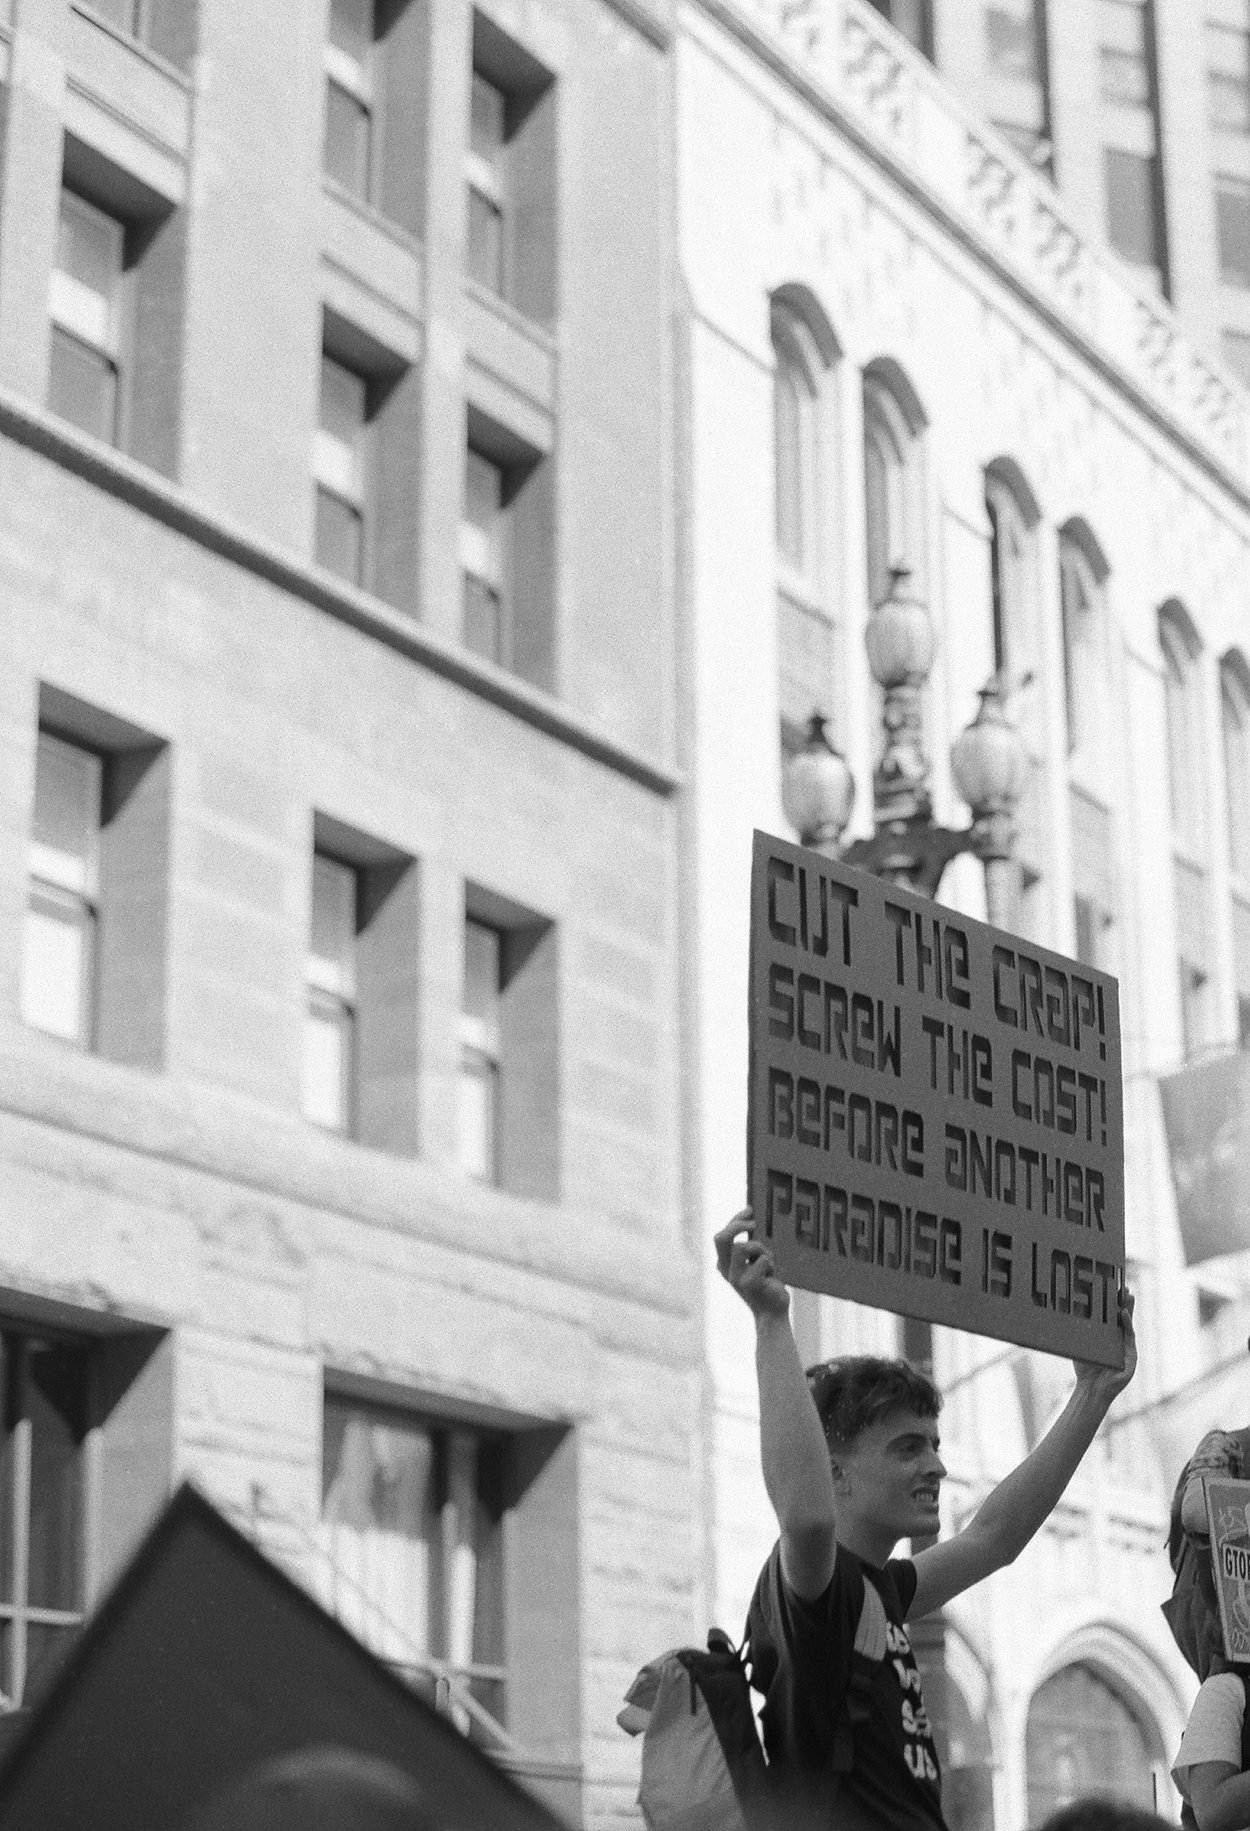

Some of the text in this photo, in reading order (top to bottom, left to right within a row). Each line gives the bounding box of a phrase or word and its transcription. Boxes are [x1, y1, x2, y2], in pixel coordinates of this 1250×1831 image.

[767, 856, 859, 968] CUT
[1011, 1048, 1107, 1147] COST!
[981, 1227, 1013, 1299] IS
